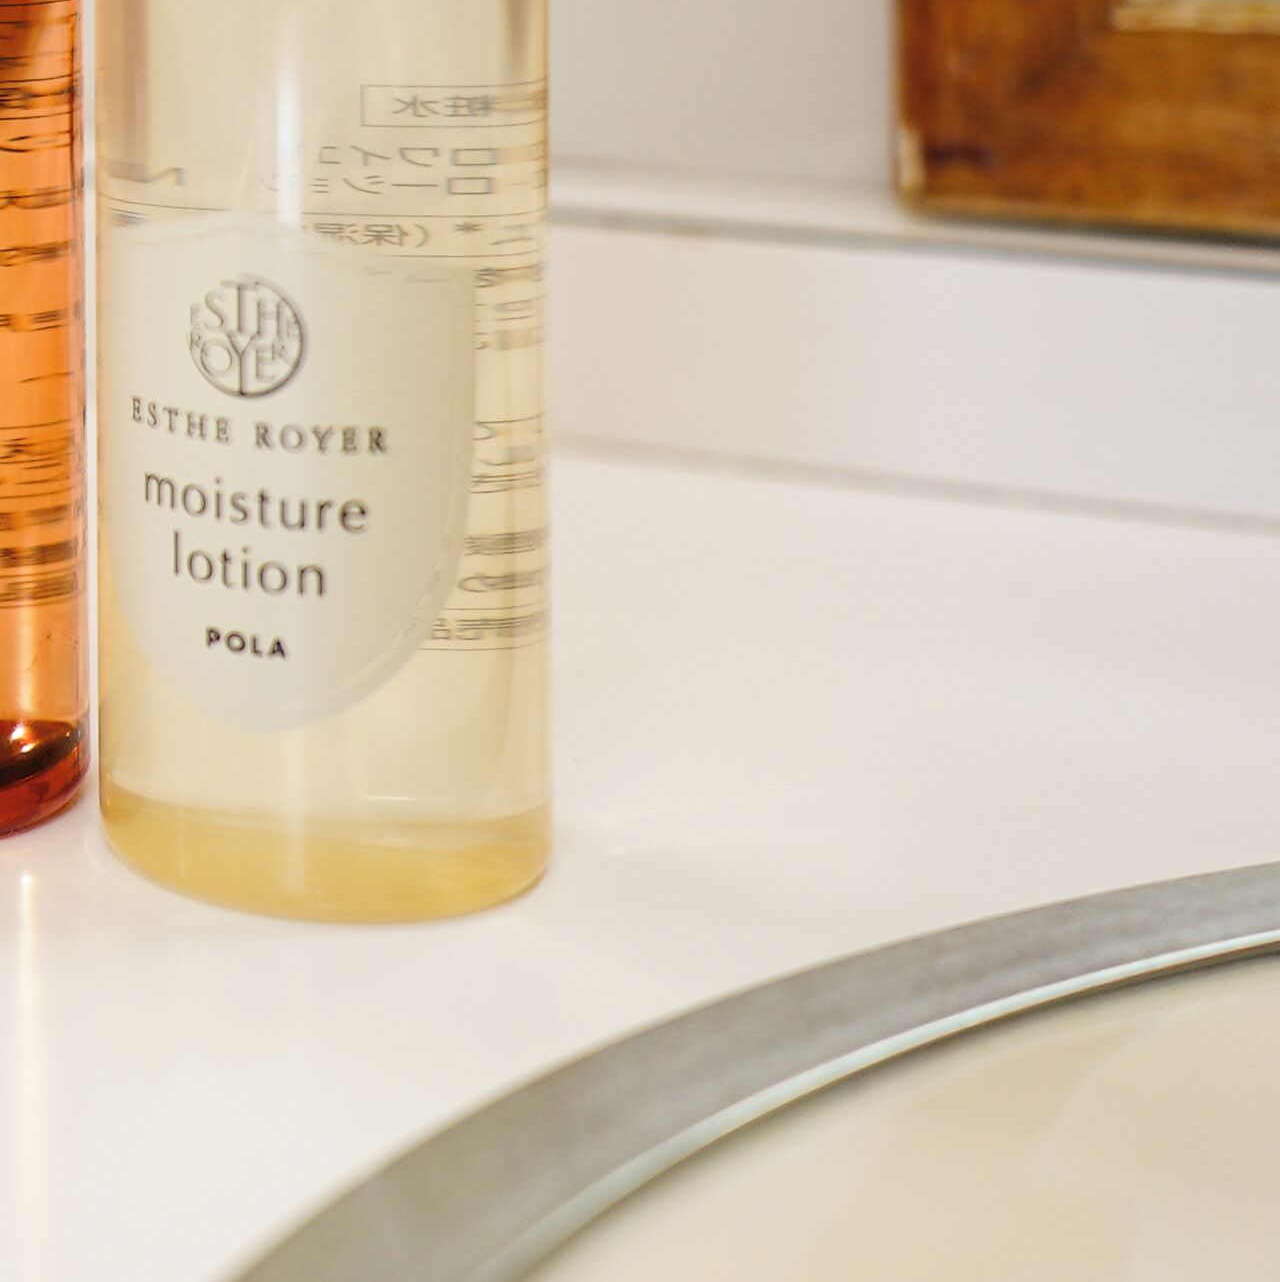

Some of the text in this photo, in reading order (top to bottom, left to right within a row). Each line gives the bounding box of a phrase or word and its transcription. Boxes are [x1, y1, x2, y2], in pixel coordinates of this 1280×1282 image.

[131, 396, 389, 455] ESTHE ROYER
[144, 471, 369, 533] moisture
[173, 530, 327, 598] lotion
[205, 627, 287, 659] POLA
